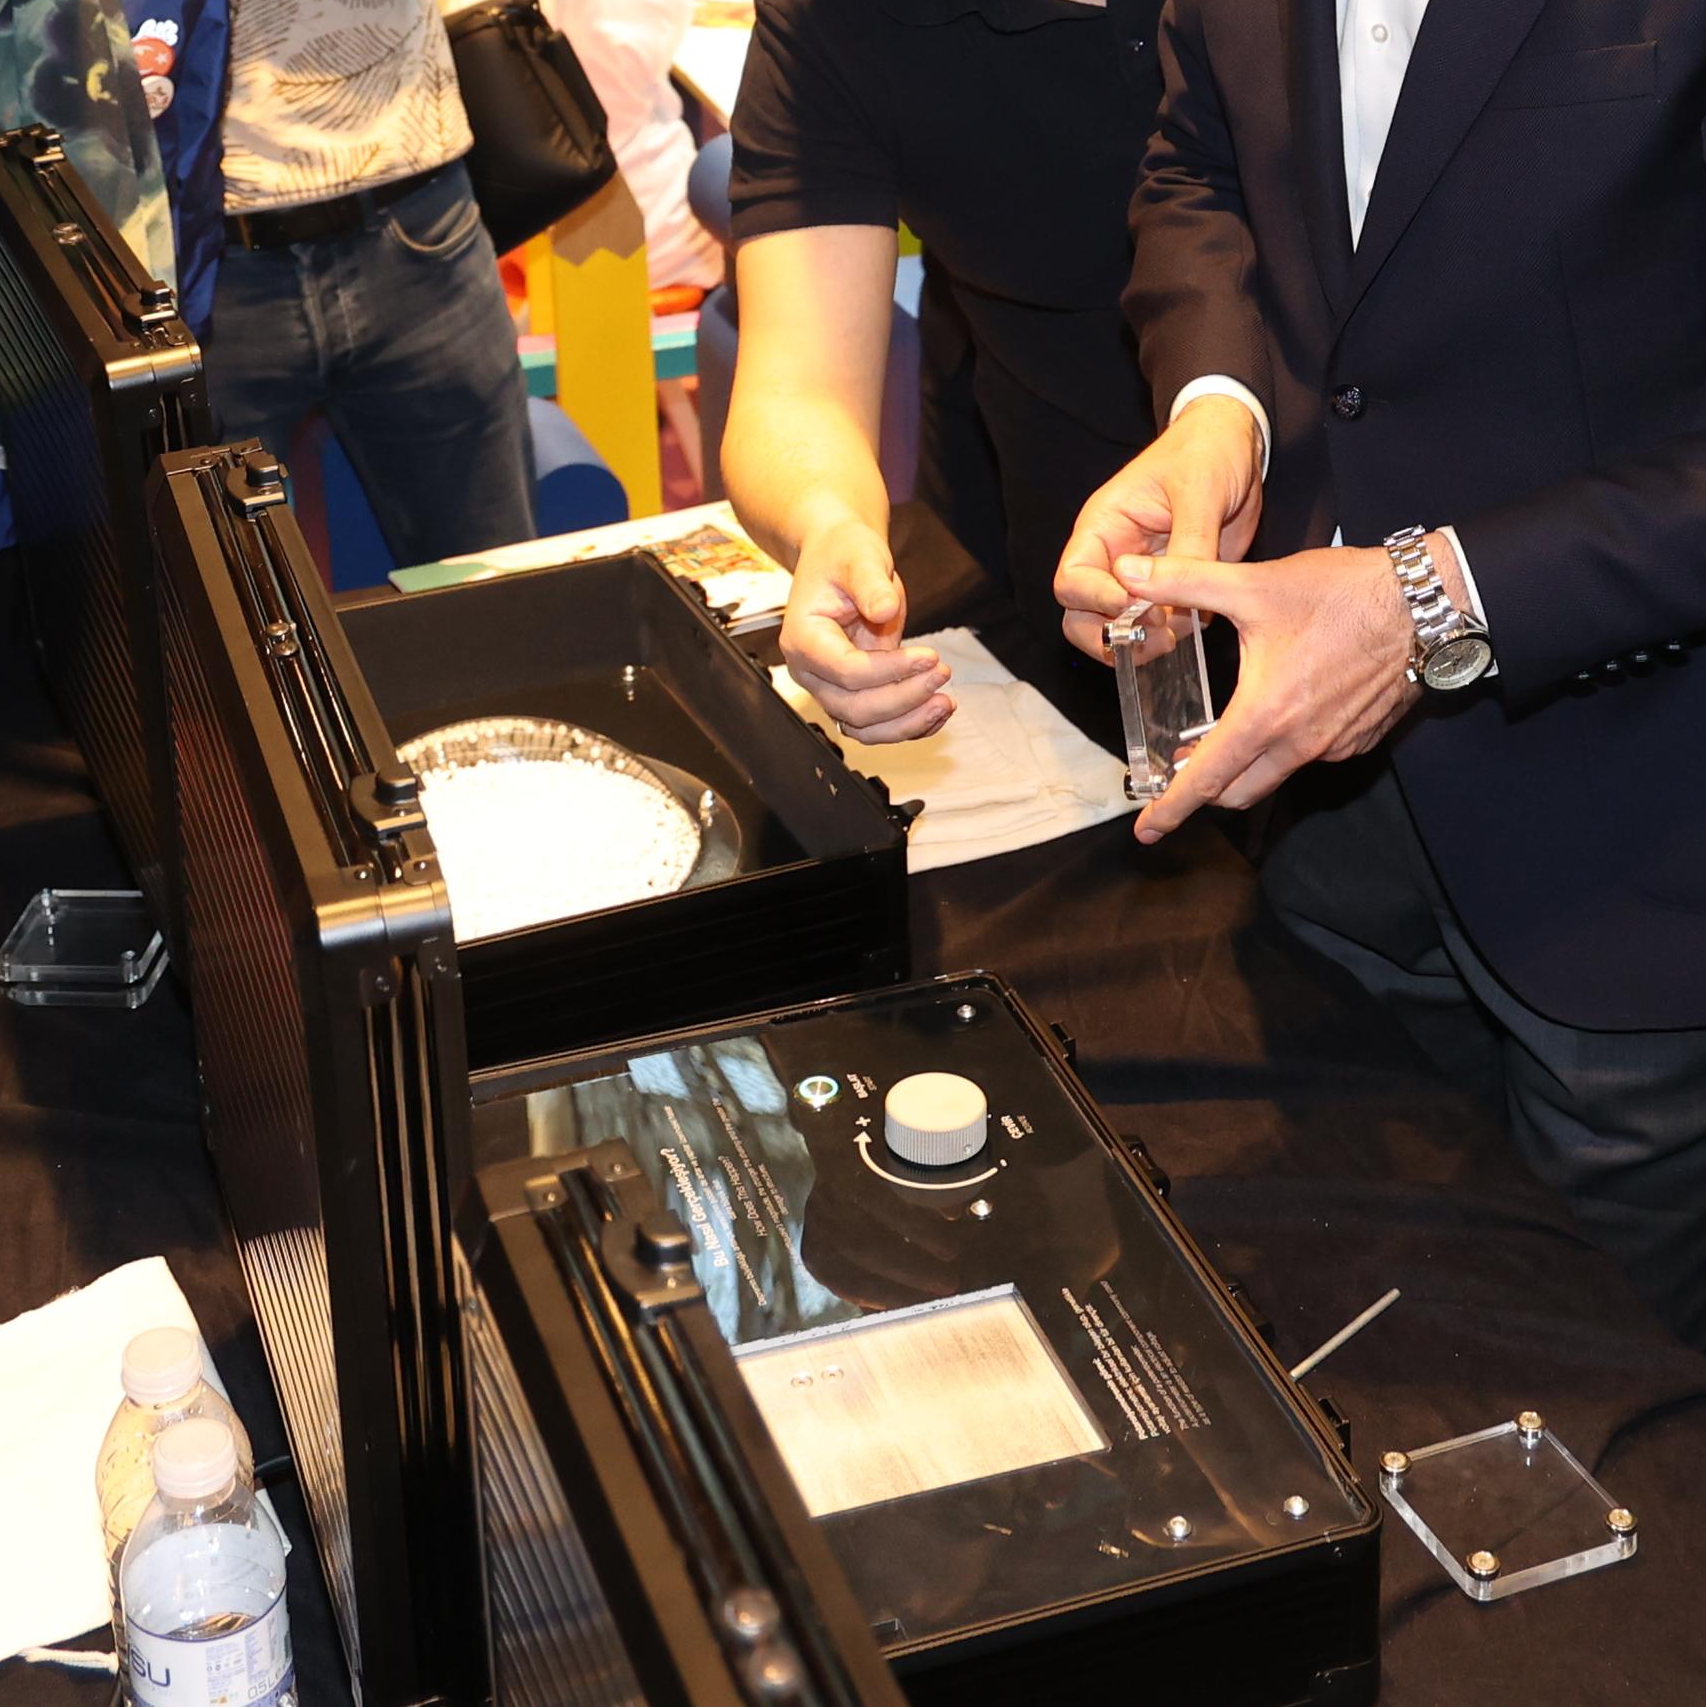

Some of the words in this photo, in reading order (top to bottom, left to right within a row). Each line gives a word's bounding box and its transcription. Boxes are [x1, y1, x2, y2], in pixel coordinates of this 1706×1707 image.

[660, 1148, 707, 1223] Gerçekleşiyor?
[696, 1223, 721, 1250] Nasıl
[714, 1251, 729, 1267] Bu
[127, 1643, 171, 1687] SU
